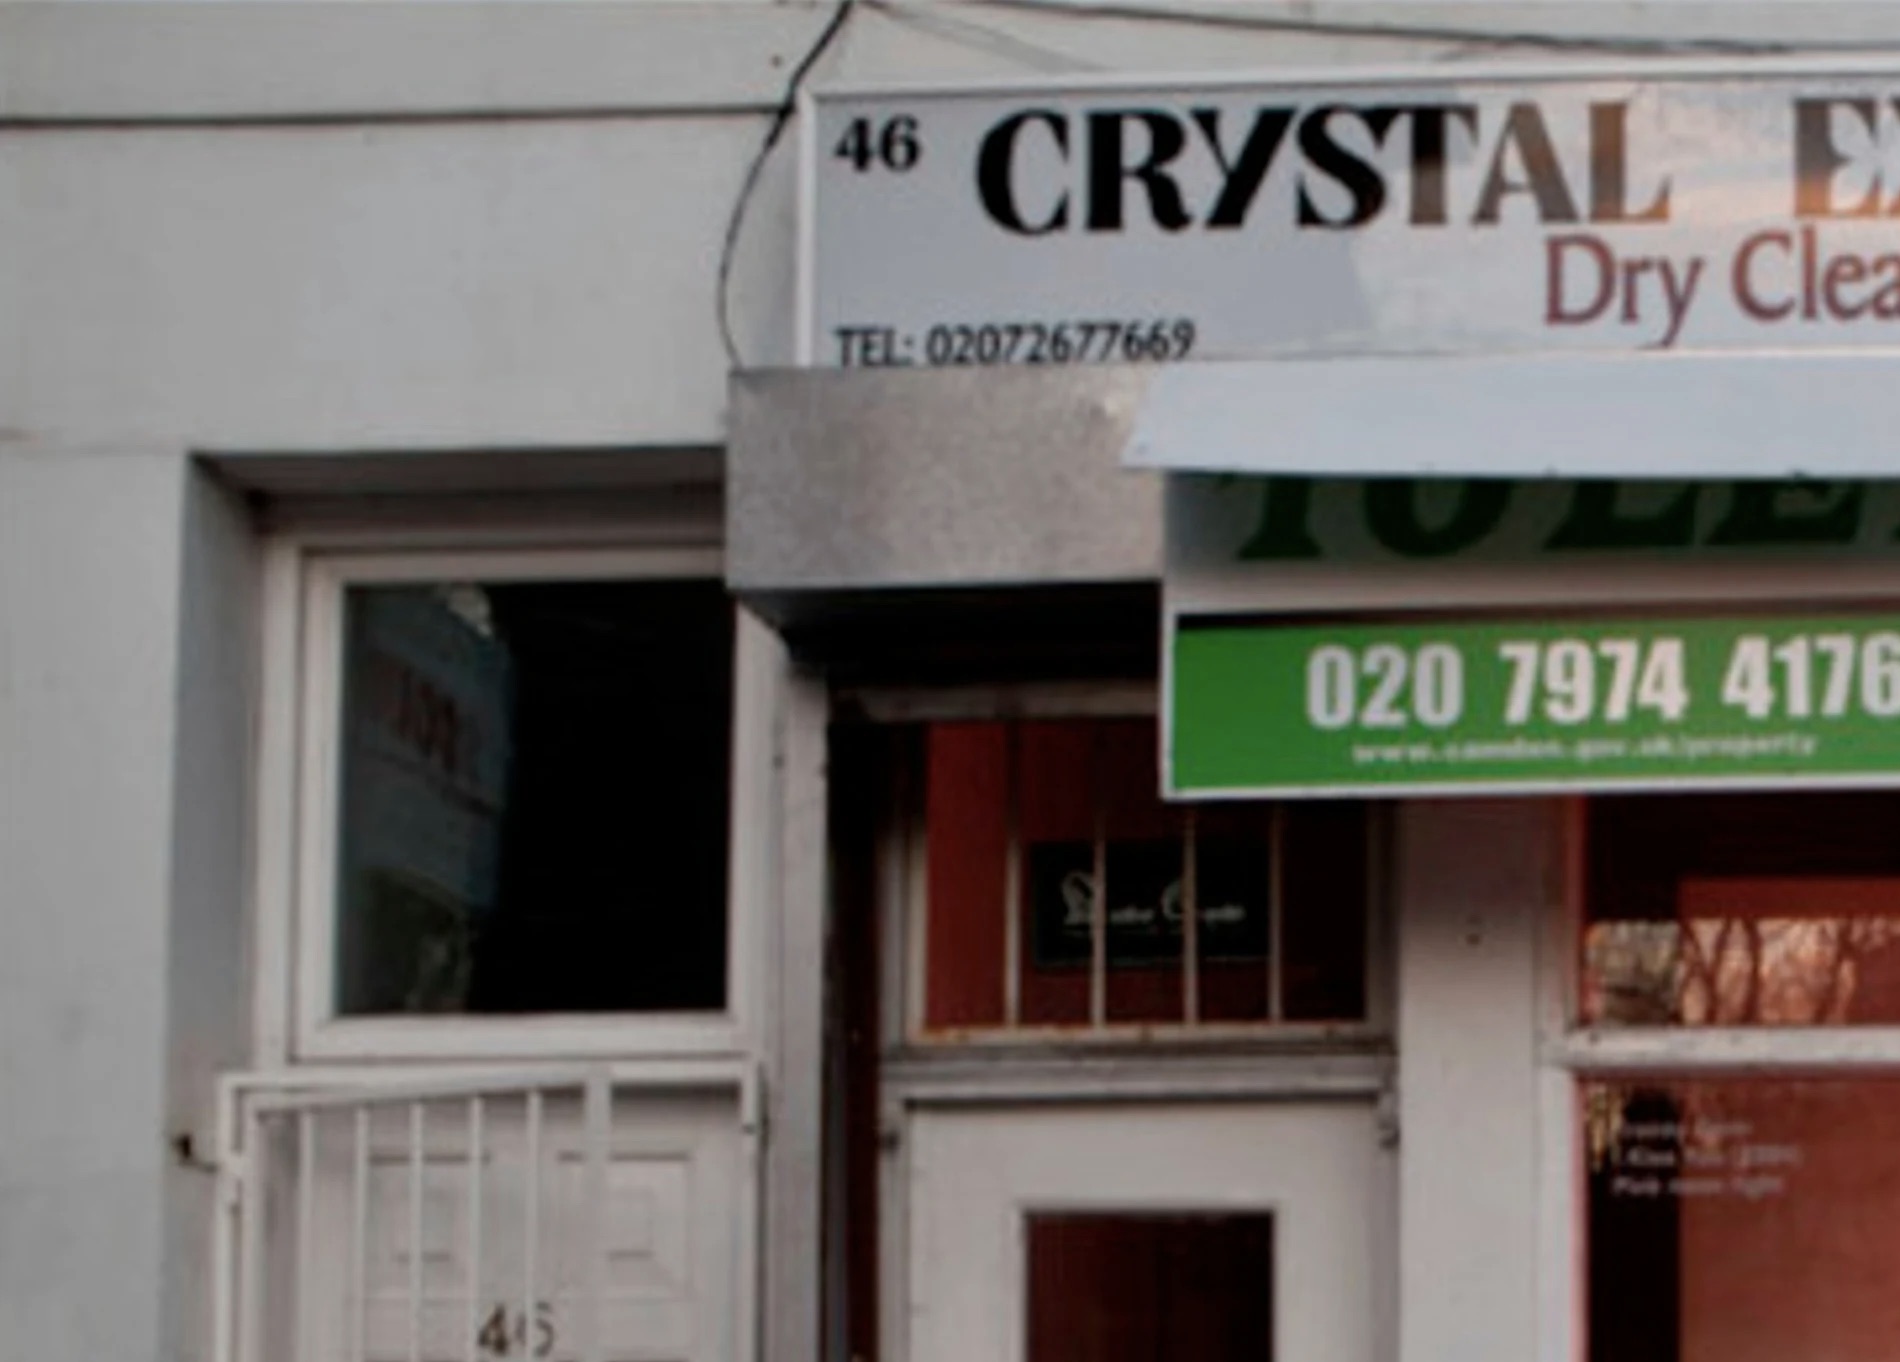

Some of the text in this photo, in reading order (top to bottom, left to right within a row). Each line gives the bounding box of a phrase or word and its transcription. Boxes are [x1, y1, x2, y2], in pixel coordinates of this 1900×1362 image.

[833, 115, 921, 173] 46
[975, 99, 1671, 234] CRYSTAL
[1544, 232, 1706, 349] Dry
[836, 321, 1196, 367] TEL: 02072677669
[1305, 642, 1463, 730] 020
[1498, 636, 1689, 727] 7974
